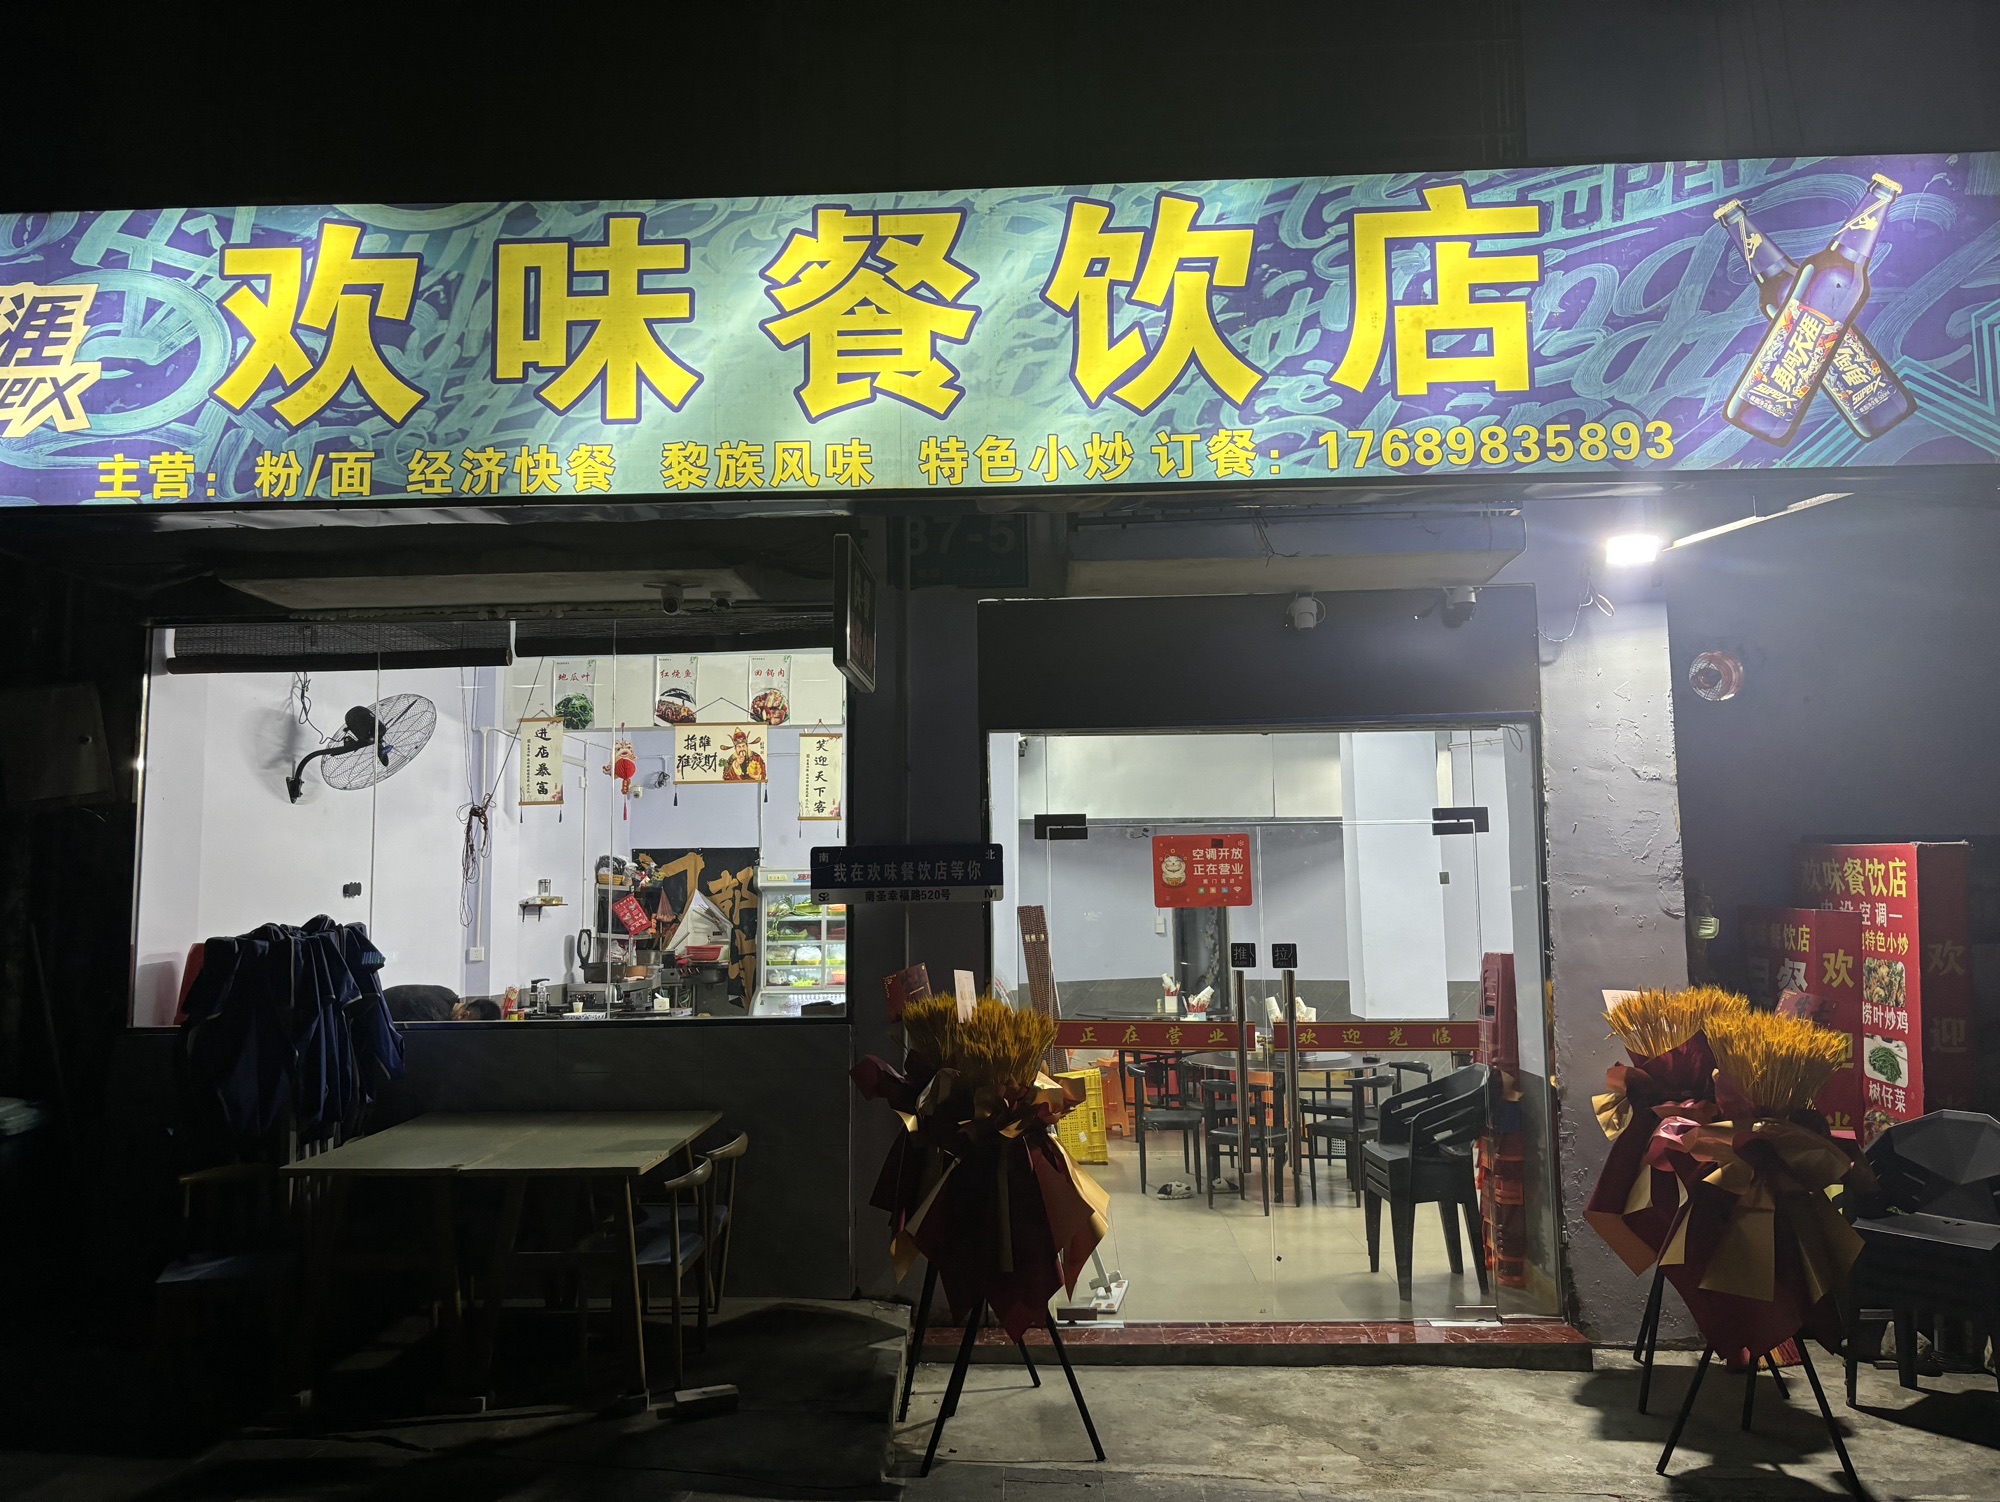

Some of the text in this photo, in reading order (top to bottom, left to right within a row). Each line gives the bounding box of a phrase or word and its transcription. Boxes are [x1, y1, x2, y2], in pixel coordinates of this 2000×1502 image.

[212, 184, 1540, 427] 欢味餐饮店
[254, 451, 376, 498] 粉/面
[406, 442, 616, 496] 经济快餐
[660, 437, 875, 491] 黎族风味
[918, 431, 1133, 485] 特色小炒
[1317, 420, 1675, 470] 17689835893
[557, 671, 591, 683] 地瓜叶
[659, 668, 693, 679] 红烧鱼
[534, 727, 552, 796] 进店暴富
[813, 738, 830, 814] 笑迎天下客
[818, 848, 997, 864] 南 北
[1192, 847, 1243, 861] 空调开放
[833, 859, 983, 883] 我在欢味餐饮店等你
[1192, 863, 1244, 876] 正在营业
[1801, 856, 1908, 898] 欢味餐饮店
[864, 888, 952, 903] 南圣幸福路520号
[1862, 930, 1909, 956] 特色小炒
[1233, 946, 1247, 961] 推
[1274, 947, 1288, 961] 拉
[1079, 1025, 1229, 1046] 正在营业
[1298, 1026, 1452, 1046] 欢迎光临
[1868, 1080, 1907, 1114] 树仔菜
